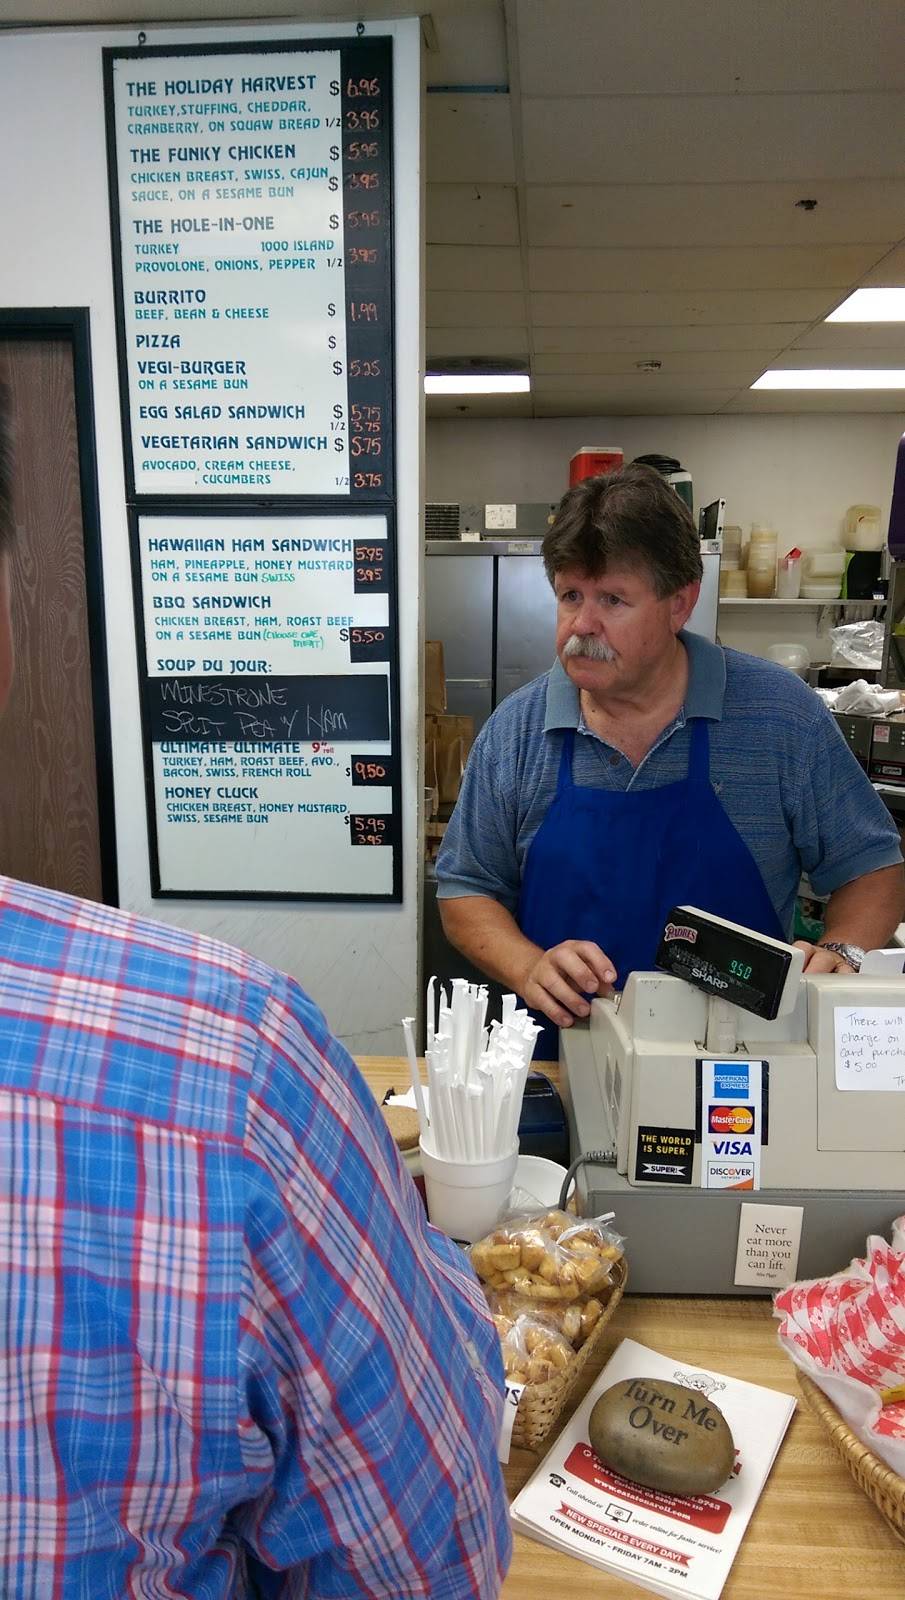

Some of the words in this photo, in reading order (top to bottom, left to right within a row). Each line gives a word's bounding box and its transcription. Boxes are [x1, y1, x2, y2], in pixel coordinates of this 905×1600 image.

[126, 81, 156, 97] THE
[164, 78, 233, 95] HOLIDAY
[241, 74, 317, 93] HARVEST
[346, 78, 380, 97] 6.95
[247, 101, 312, 113] CHEDDAR,
[127, 122, 204, 135] CRANBERRY,
[208, 121, 225, 132] ON
[230, 120, 274, 132] SQUAW
[279, 118, 321, 130] BREAD
[346, 110, 380, 130] 3.95
[130, 148, 161, 164] THE
[168, 146, 221, 163] FUNKY
[228, 144, 296, 161] CHICKEN
[130, 172, 181, 184] CHICKEN
[186, 170, 239, 183] BREAST,
[244, 168, 285, 181] SWISS,
[290, 167, 329, 180] CAJUN
[131, 190, 173, 203] SAUCE,
[178, 189, 196, 200] ON
[202, 188, 211, 200] A
[216, 187, 263, 200] SESAME
[268, 186, 295, 198] BUN
[133, 218, 163, 235] THE
[170, 216, 275, 233] HOLE-IN-ONE
[135, 243, 180, 255] TURKEY
[260, 240, 289, 252] 1000
[293, 239, 335, 252] ISLAND
[135, 260, 210, 273] PROVOLONE,
[214, 259, 263, 272] ONIONS,
[269, 258, 316, 271] PEPPER
[134, 290, 207, 306] BURRITO
[135, 308, 169, 321] BEEF,
[174, 308, 207, 320] BEAN
[212, 308, 220, 320] &
[224, 308, 271, 319] CHEESE
[350, 302, 378, 322] 1.99
[136, 334, 181, 349] PIZZA
[137, 360, 247, 376] VEGI-BURGER
[138, 380, 155, 391] ON
[160, 380, 168, 390] A
[173, 379, 218, 390] SESAME
[224, 379, 249, 390] BUN
[140, 406, 168, 420] EGG
[175, 406, 222, 421] SALAD
[228, 405, 306, 420] SANDWICH
[140, 436, 239, 451] VEGETARIAN
[246, 436, 328, 451] SANDWICH
[142, 460, 200, 472] AVOCADO,
[205, 460, 245, 472] CREAM
[249, 460, 296, 473] CHEESE,
[203, 474, 272, 485] CUCUMBERS
[148, 538, 225, 553] HAWAIIAN
[232, 539, 265, 552] HAM
[272, 538, 352, 553] SANDWICH
[150, 560, 179, 571] HAM,
[185, 560, 250, 571] PINEAPPLE,
[254, 560, 293, 571] HONEY
[298, 560, 354, 571] MUSTARD
[152, 572, 167, 582] ON
[172, 572, 180, 582] A
[186, 572, 229, 582] SESAME
[234, 572, 259, 582] BUN
[152, 596, 185, 609] BBQ
[192, 596, 272, 609] SANDWICH
[154, 617, 199, 626] CHICKEN
[204, 616, 250, 627] BREAST,
[254, 616, 282, 627] HAM,
[286, 616, 322, 626] ROAST
[326, 616, 354, 626] BEEF
[156, 630, 171, 641] ON
[176, 630, 184, 641] A
[189, 630, 233, 641] SESAME
[238, 630, 261, 641] BUN
[352, 630, 385, 643] 5.50
[157, 660, 196, 672] SOUP
[202, 660, 223, 672] DU
[230, 660, 272, 674] JOUR:
[161, 680, 287, 708] MINESTRONE
[306, 704, 348, 737] HAM
[163, 757, 207, 766] TURKEY,
[210, 757, 237, 766] HAM,
[240, 757, 274, 766] ROAST
[279, 757, 308, 766] BEEF,
[163, 768, 202, 778] BACON,
[206, 768, 239, 778] SWISS,
[242, 768, 282, 777] FRENCH
[286, 768, 312, 777] ROLL
[164, 787, 211, 799] HONEY
[217, 787, 259, 799] CLUCK
[166, 803, 210, 812] CHICKEN
[212, 803, 256, 812] BREAST,
[259, 804, 293, 813] HONEY
[298, 804, 350, 814] MUSTARD,
[168, 814, 200, 823] SWISS,
[204, 814, 243, 823] SESAME
[246, 814, 269, 823] BUN
[355, 817, 386, 832] 5.95
[666, 924, 697, 942] PADRES
[692, 968, 729, 989] SHARP
[846, 1012, 878, 1026] There
[885, 1016, 903, 1025] will
[712, 1116, 752, 1124] MasterCard
[641, 1134, 657, 1143] THE
[660, 1136, 691, 1145] WORLD
[644, 1145, 653, 1153] IS
[656, 1146, 688, 1155] SUPER.
[713, 1142, 752, 1155] VISA
[710, 1168, 751, 1176] DISCOVER
[755, 1224, 788, 1235] Never
[766, 1239, 792, 1247] more
[746, 1248, 769, 1257] than
[772, 1252, 791, 1260] you
[624, 1380, 676, 1413] Turn
[682, 1399, 717, 1431] Me
[629, 1406, 688, 1445] Over
[566, 1508, 586, 1524] NEW
[587, 1518, 628, 1542] SPECIALS
[630, 1537, 660, 1555] EVERY
[660, 1548, 681, 1562] DAY!
[550, 1514, 571, 1531] OPEN
[572, 1528, 606, 1547] MONDAY
[612, 1546, 646, 1563] FRIDAY
[644, 1558, 662, 1569] 7AM
[669, 1566, 688, 1578] 2PM
